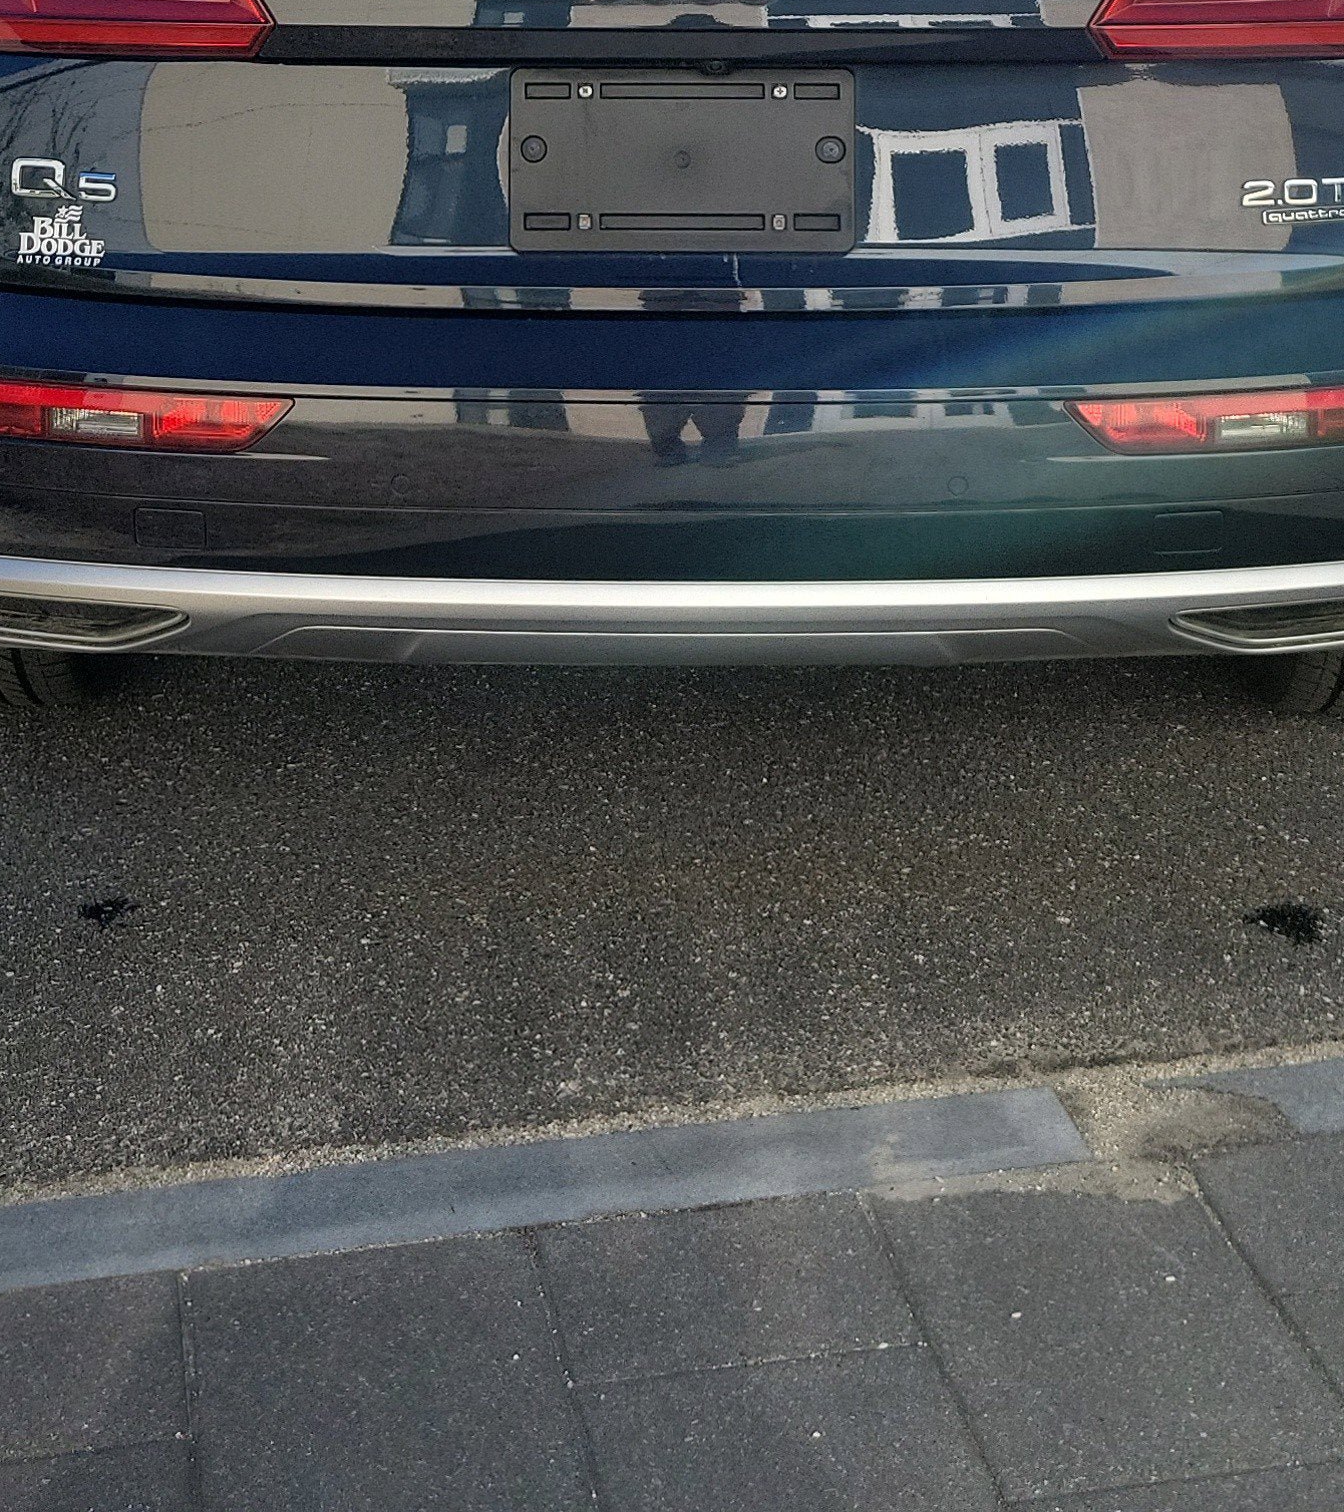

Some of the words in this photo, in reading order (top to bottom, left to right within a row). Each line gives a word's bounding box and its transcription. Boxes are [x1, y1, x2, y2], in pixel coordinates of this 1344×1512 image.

[11, 157, 117, 202] Q5
[32, 216, 87, 240] BILL
[18, 232, 105, 258] DODGE
[17, 254, 50, 265] AUTO
[54, 256, 101, 267] GROUP
